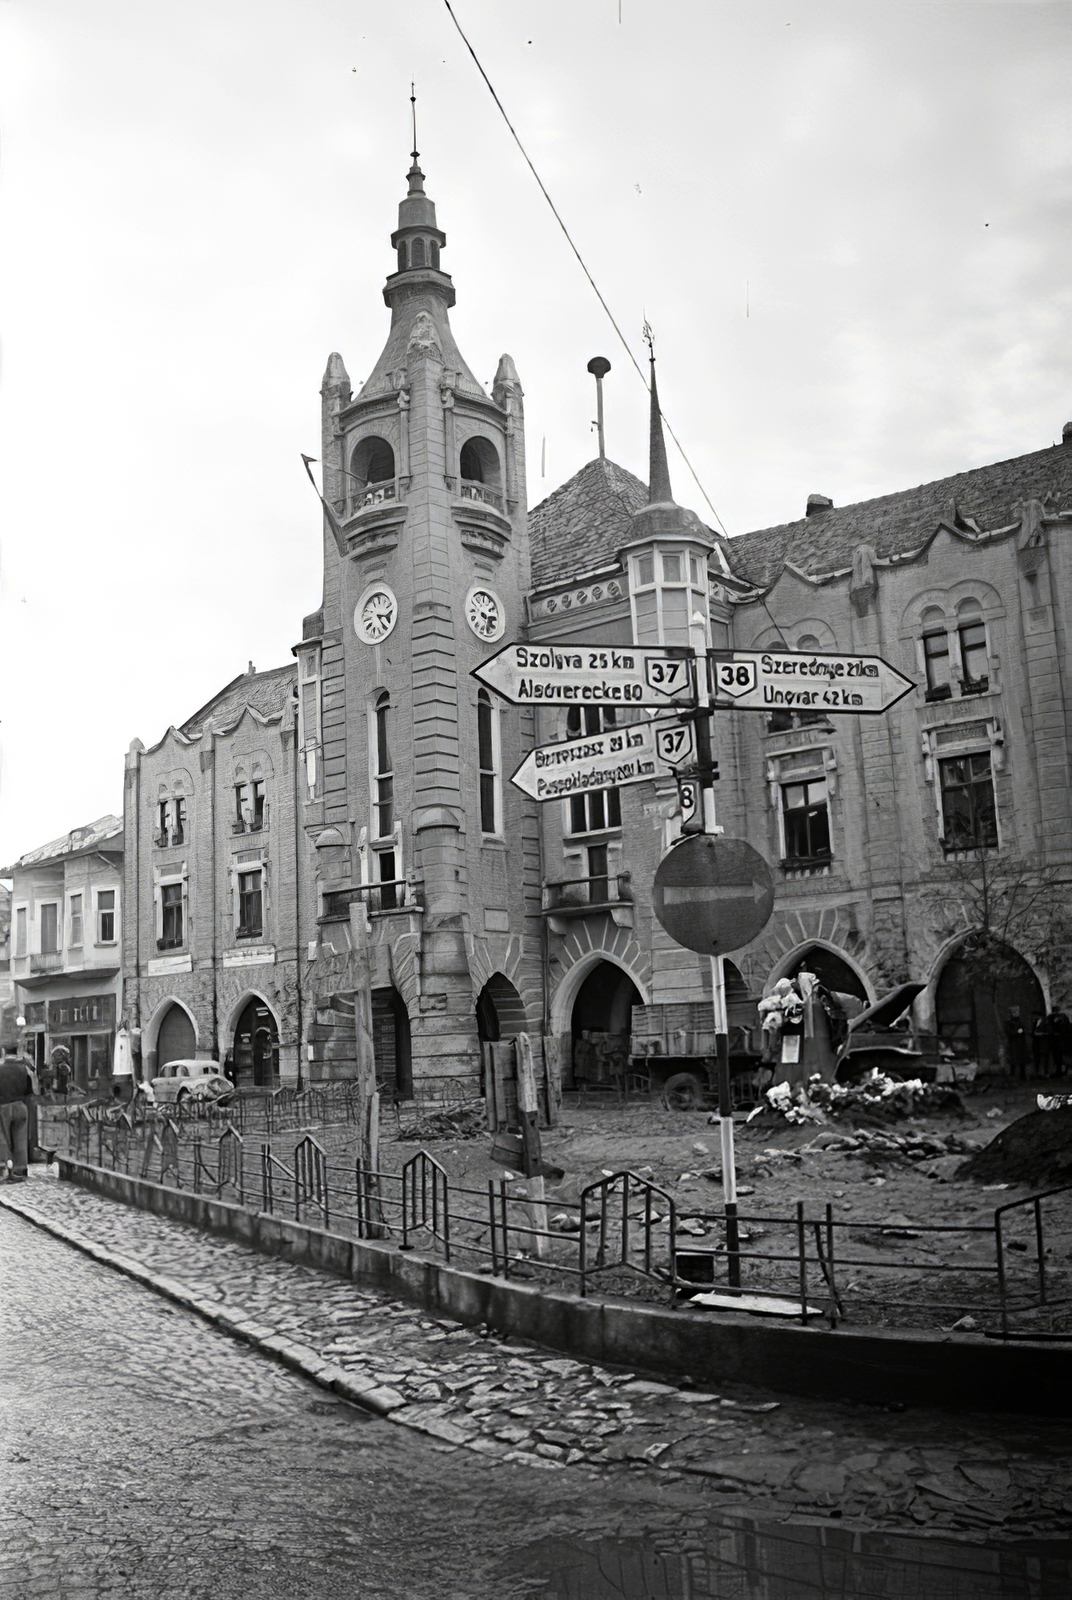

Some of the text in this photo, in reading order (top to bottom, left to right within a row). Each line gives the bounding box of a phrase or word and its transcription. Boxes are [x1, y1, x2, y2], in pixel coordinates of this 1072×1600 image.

[611, 651, 635, 669] km
[652, 663, 680, 684] 37
[721, 665, 750, 686] 38
[662, 730, 685, 753] 37
